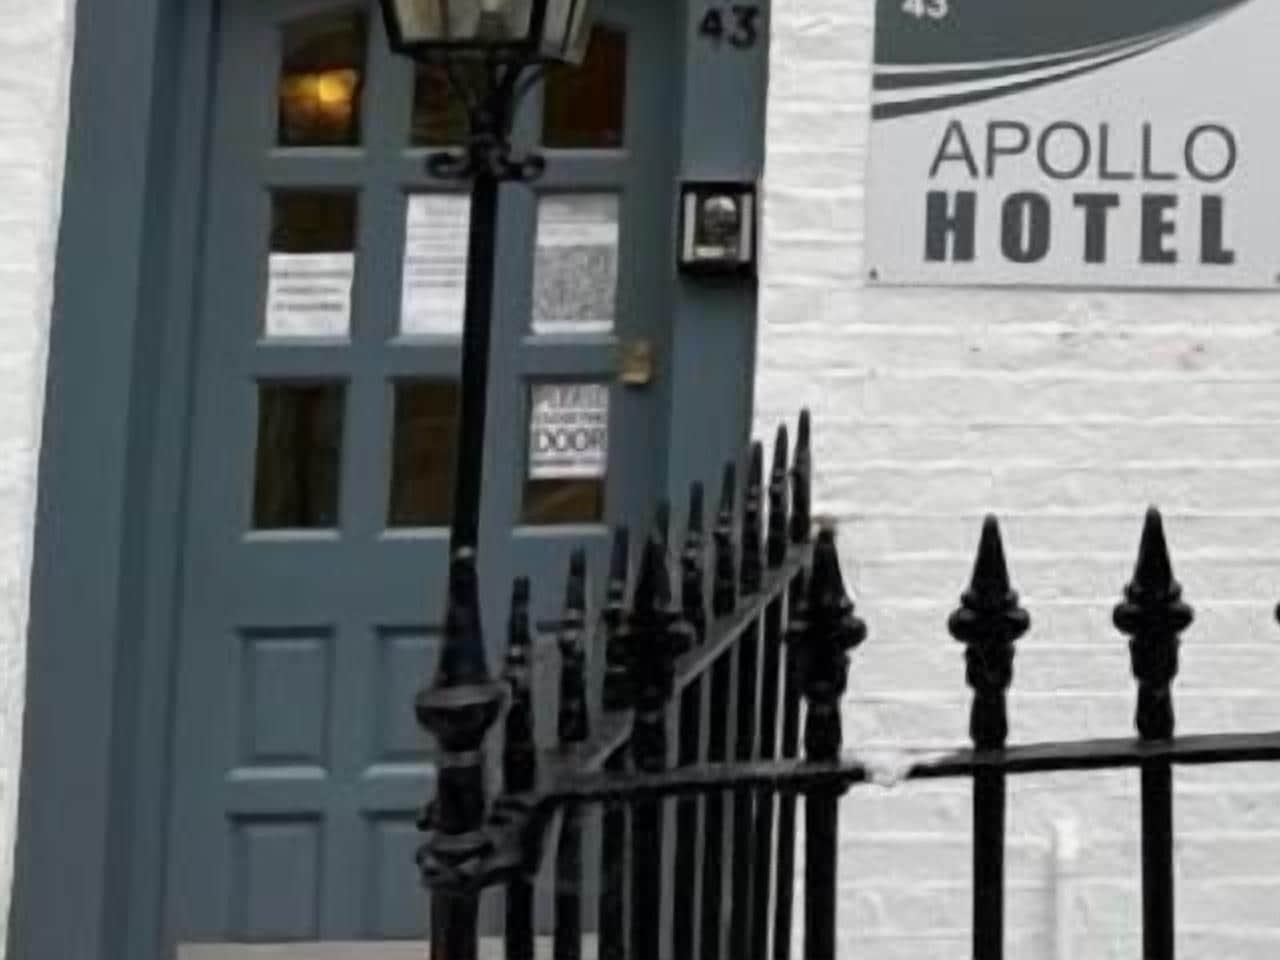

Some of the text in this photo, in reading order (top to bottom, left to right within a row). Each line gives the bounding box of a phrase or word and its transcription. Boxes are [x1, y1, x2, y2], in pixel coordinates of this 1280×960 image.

[699, 5, 759, 50] 43
[928, 119, 1238, 183] APOLLO
[923, 190, 1236, 265] HOTEL
